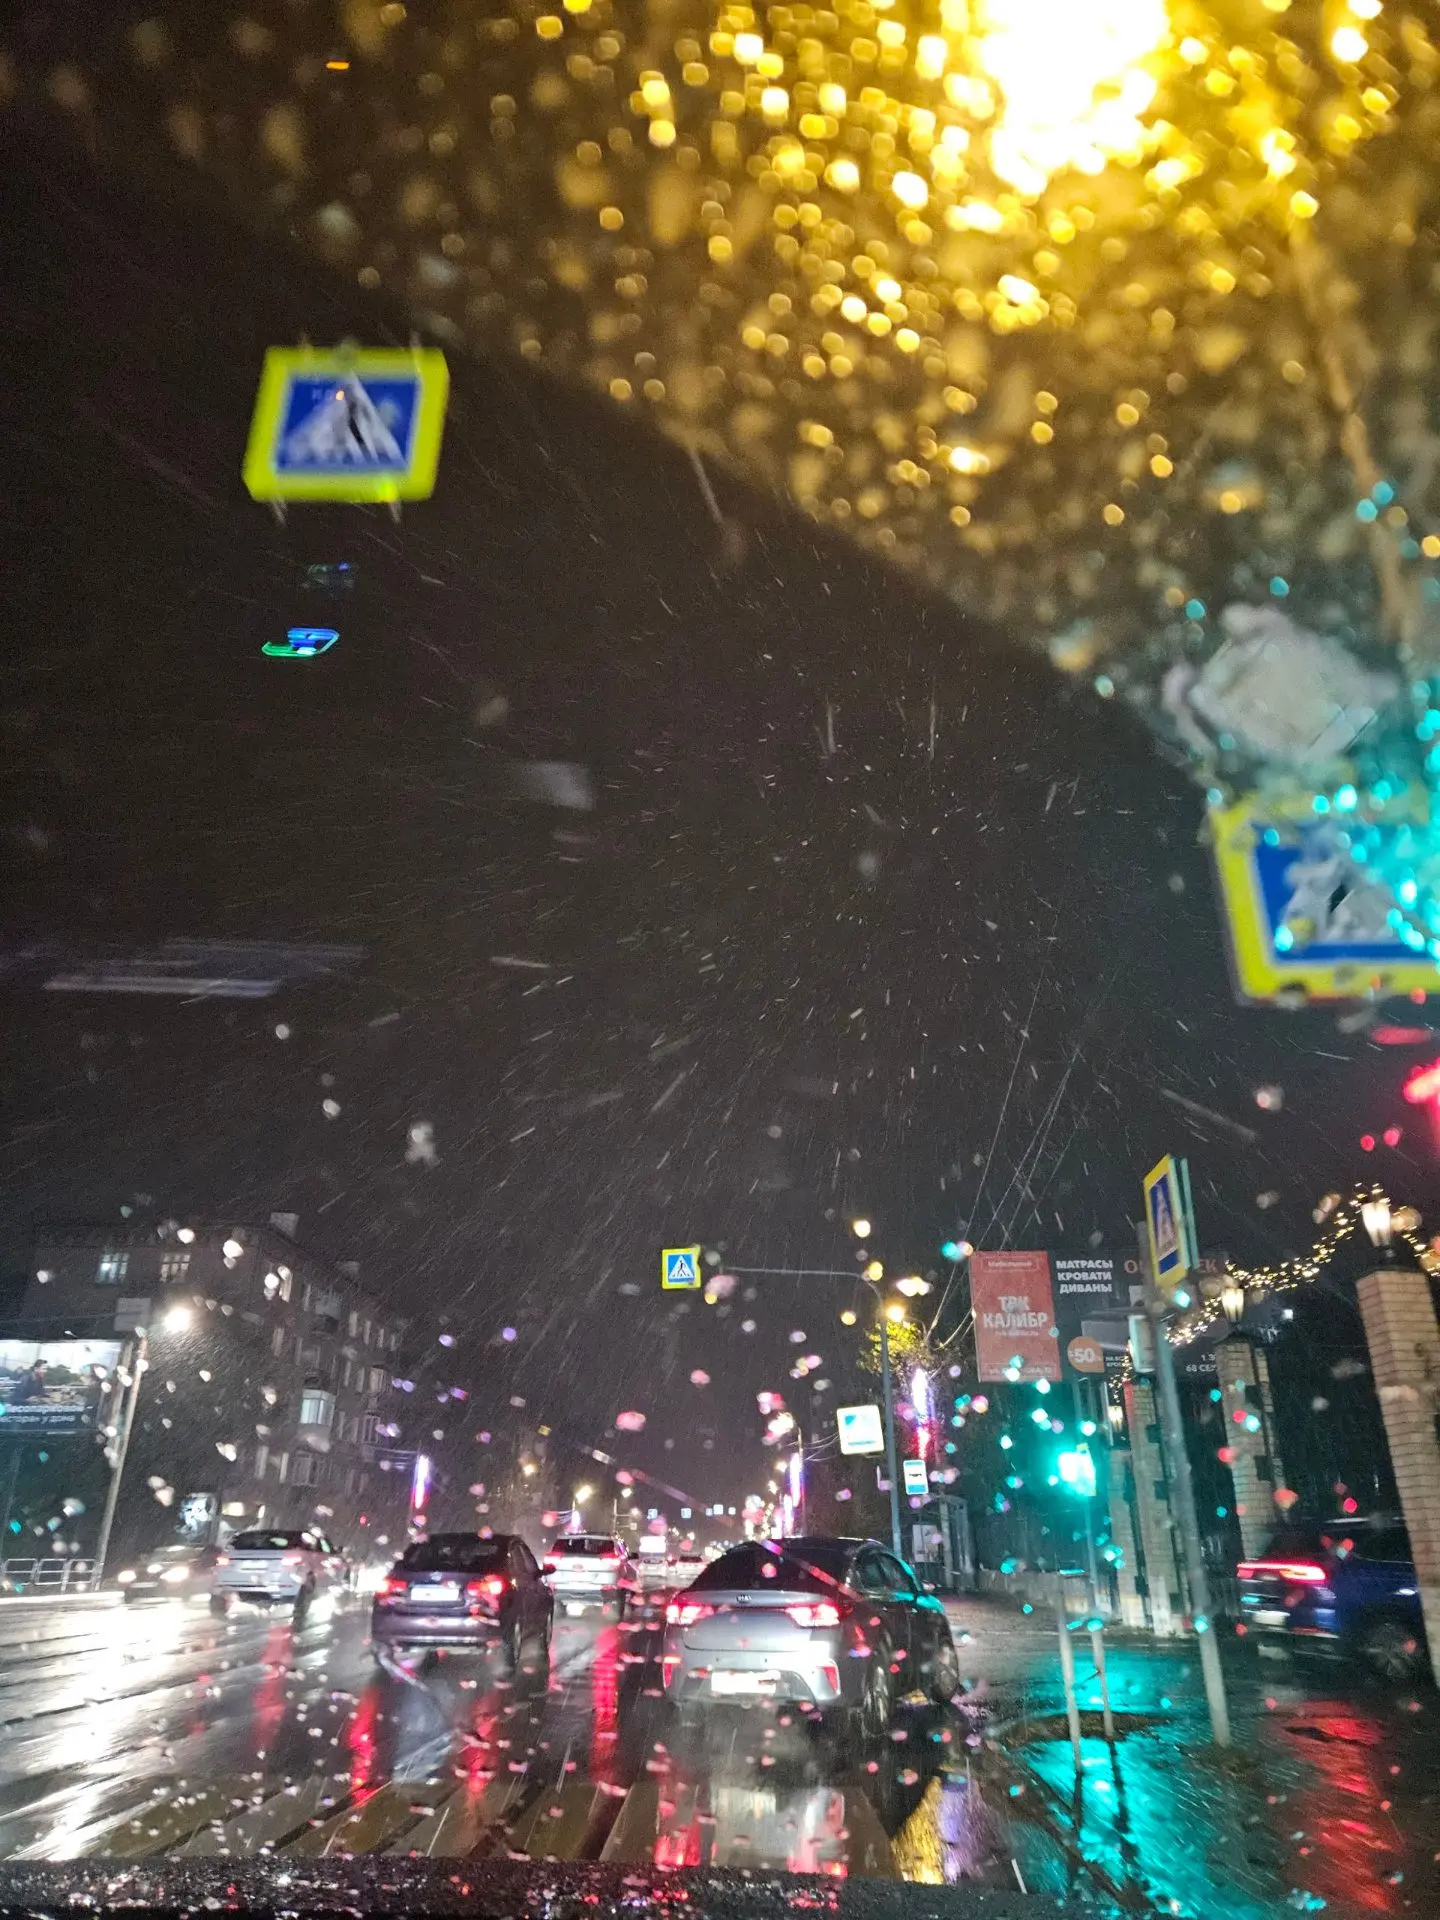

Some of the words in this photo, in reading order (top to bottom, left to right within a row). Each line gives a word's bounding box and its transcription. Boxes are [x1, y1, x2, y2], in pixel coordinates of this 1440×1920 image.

[1056, 1260, 1113, 1269] МАТРАСЫ
[1057, 1272, 1112, 1281] КРОВАТИ
[1060, 1284, 1112, 1294] ДИВАНЫ
[983, 1311, 1048, 1328] КАЛИБР
